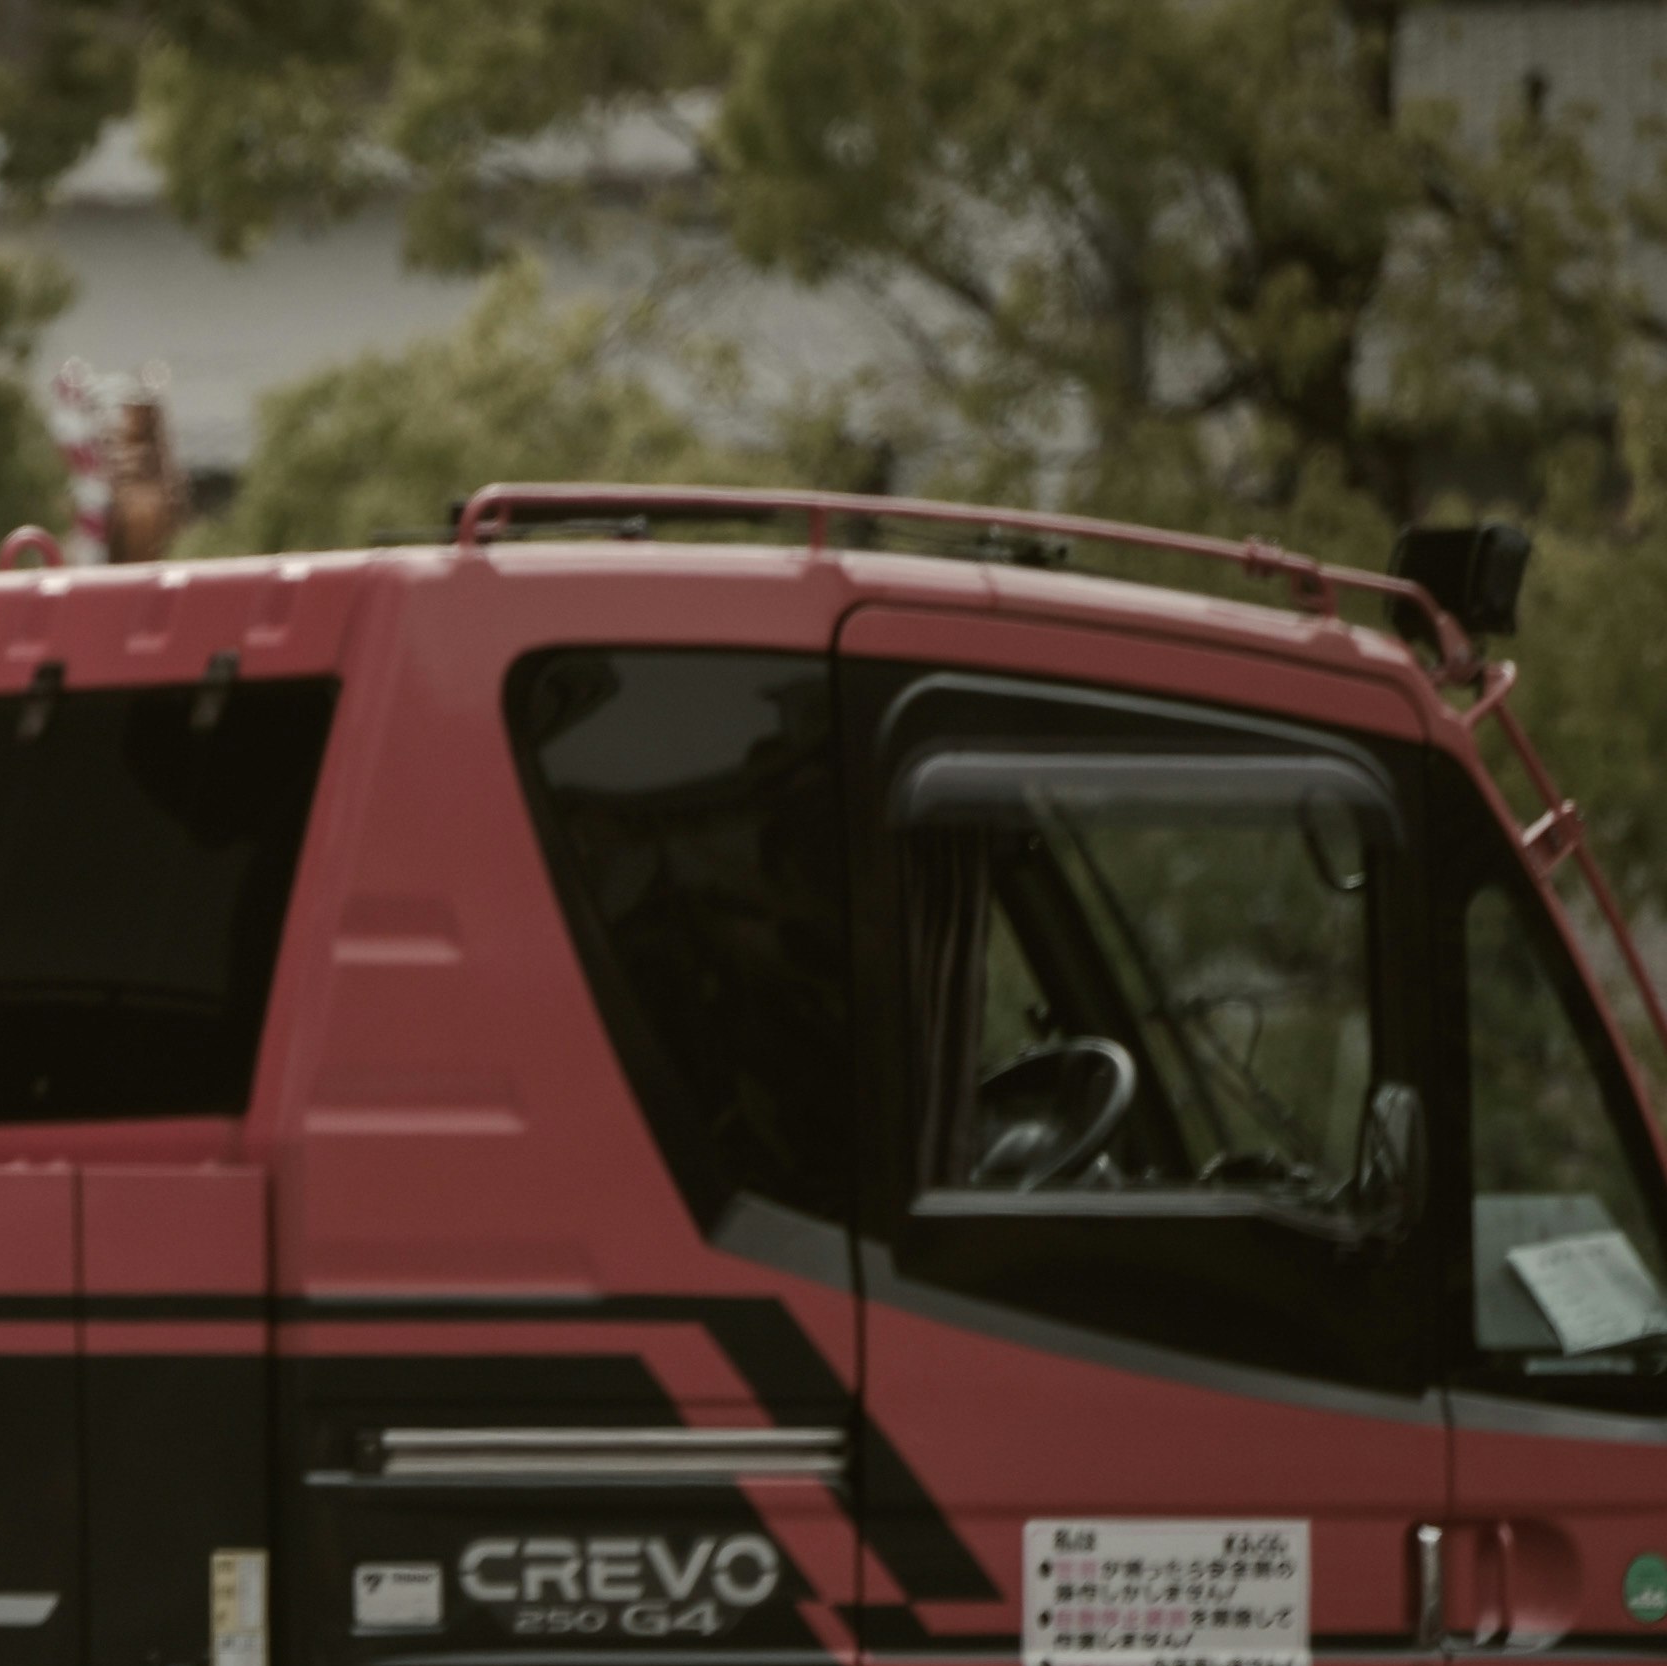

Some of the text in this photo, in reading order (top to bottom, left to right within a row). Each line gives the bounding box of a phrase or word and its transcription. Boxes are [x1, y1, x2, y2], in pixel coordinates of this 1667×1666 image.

[458, 1532, 780, 1607] CREVO
[514, 1602, 717, 1636] 250 G4
